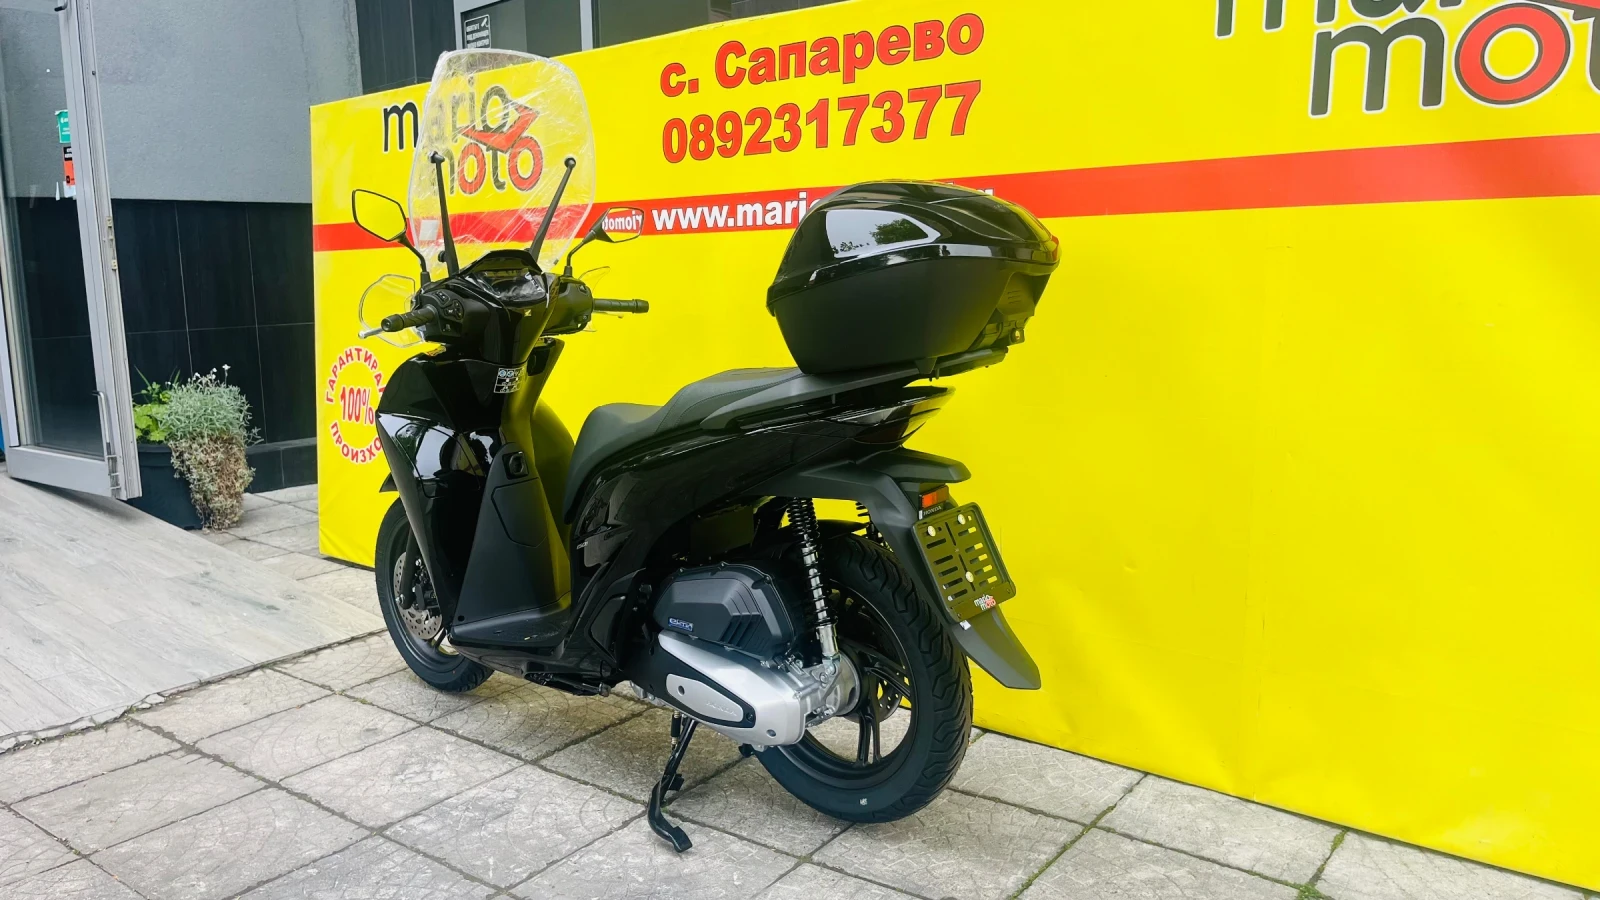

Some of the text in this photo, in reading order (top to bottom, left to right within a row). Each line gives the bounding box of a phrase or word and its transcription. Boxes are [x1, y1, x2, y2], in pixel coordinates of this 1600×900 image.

[714, 12, 985, 89] Сапарево
[662, 80, 982, 164] 0892317377
[340, 386, 375, 425] 100%
